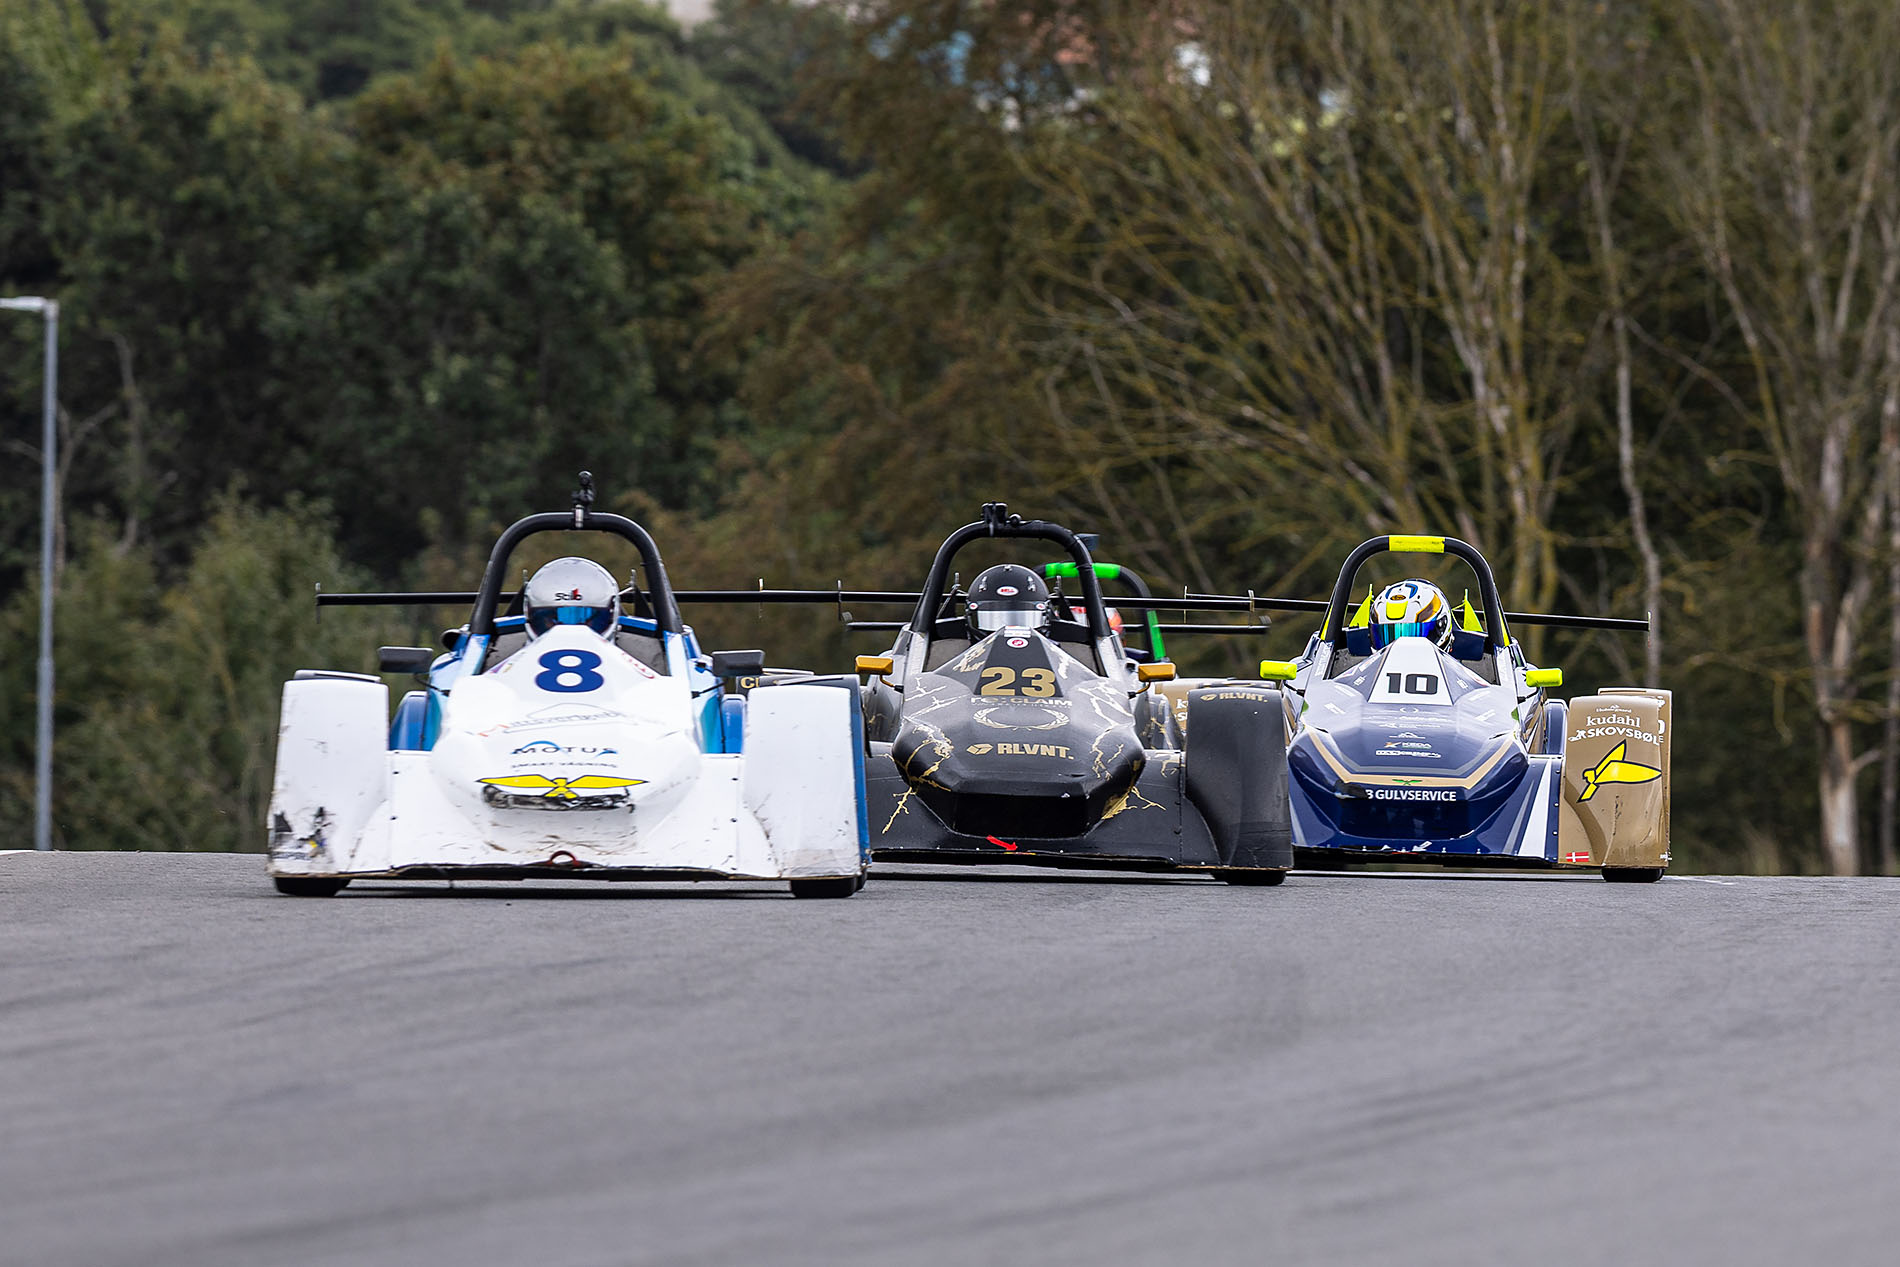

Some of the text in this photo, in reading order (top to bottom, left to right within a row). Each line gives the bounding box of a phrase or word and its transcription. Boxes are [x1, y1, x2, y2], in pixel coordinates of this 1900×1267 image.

[535, 649, 605, 693] 8
[980, 666, 1056, 698] 23
[1386, 672, 1439, 695] 10
[1586, 713, 1641, 728] kudahl
[1375, 789, 1457, 801] GULVSERVICE
